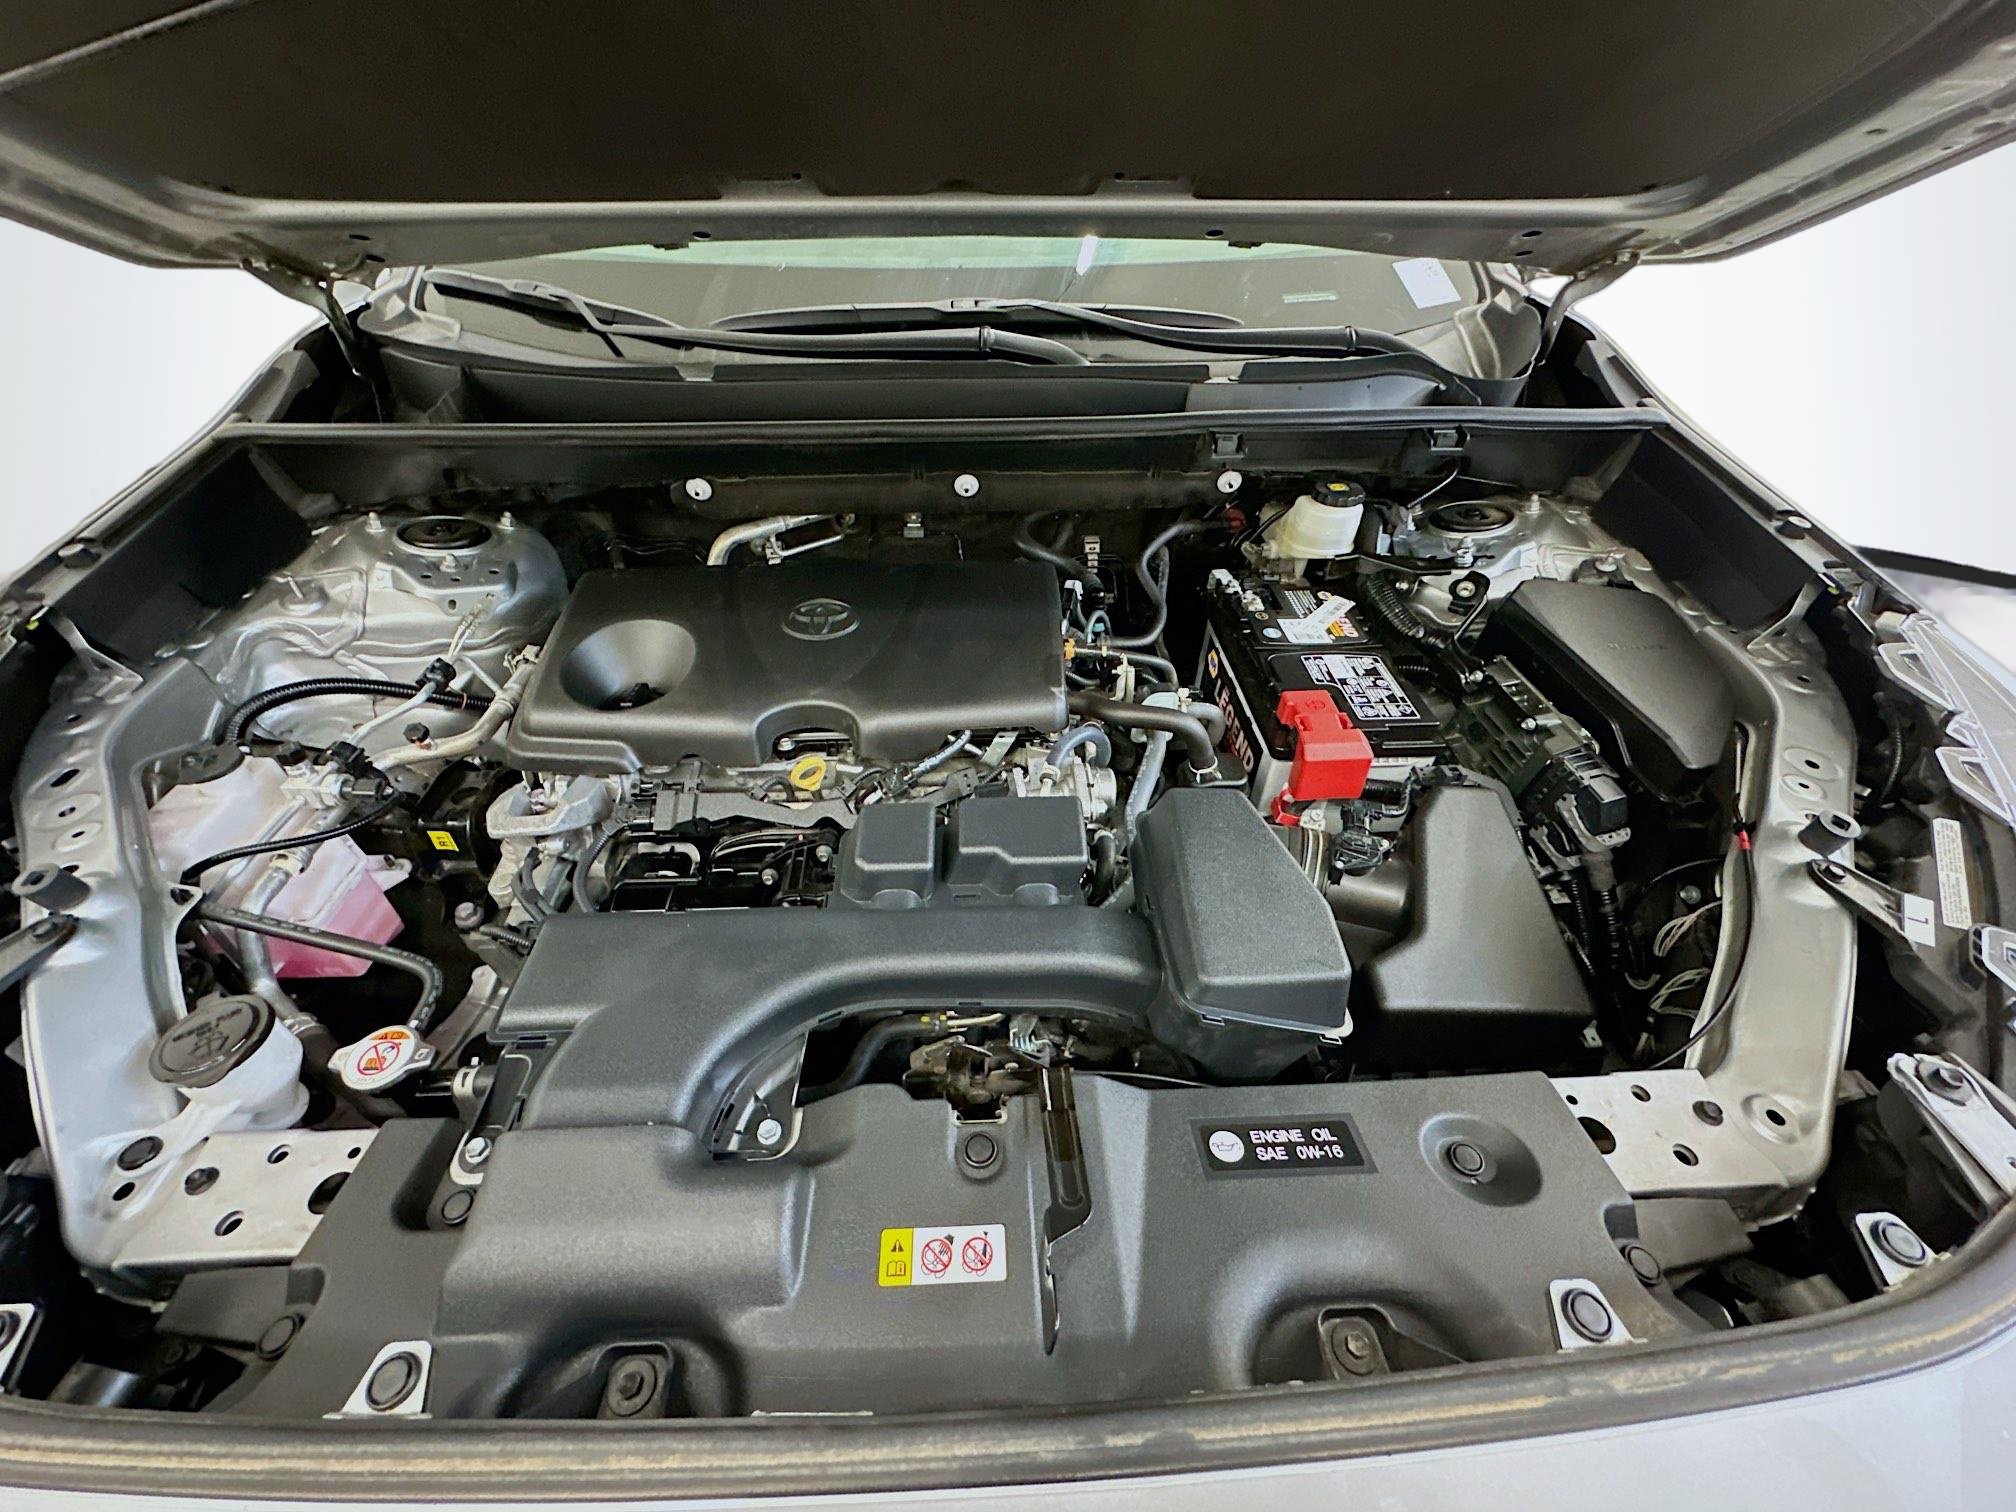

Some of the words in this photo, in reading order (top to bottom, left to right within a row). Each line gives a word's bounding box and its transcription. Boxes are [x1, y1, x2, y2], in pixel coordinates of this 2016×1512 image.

[1214, 678, 1254, 773] LEGEND
[1249, 1129, 1305, 1144] ENGINE
[1311, 1127, 1338, 1142] OIL
[1256, 1146, 1289, 1161] SAE
[1295, 1145, 1344, 1160] 0W-16
